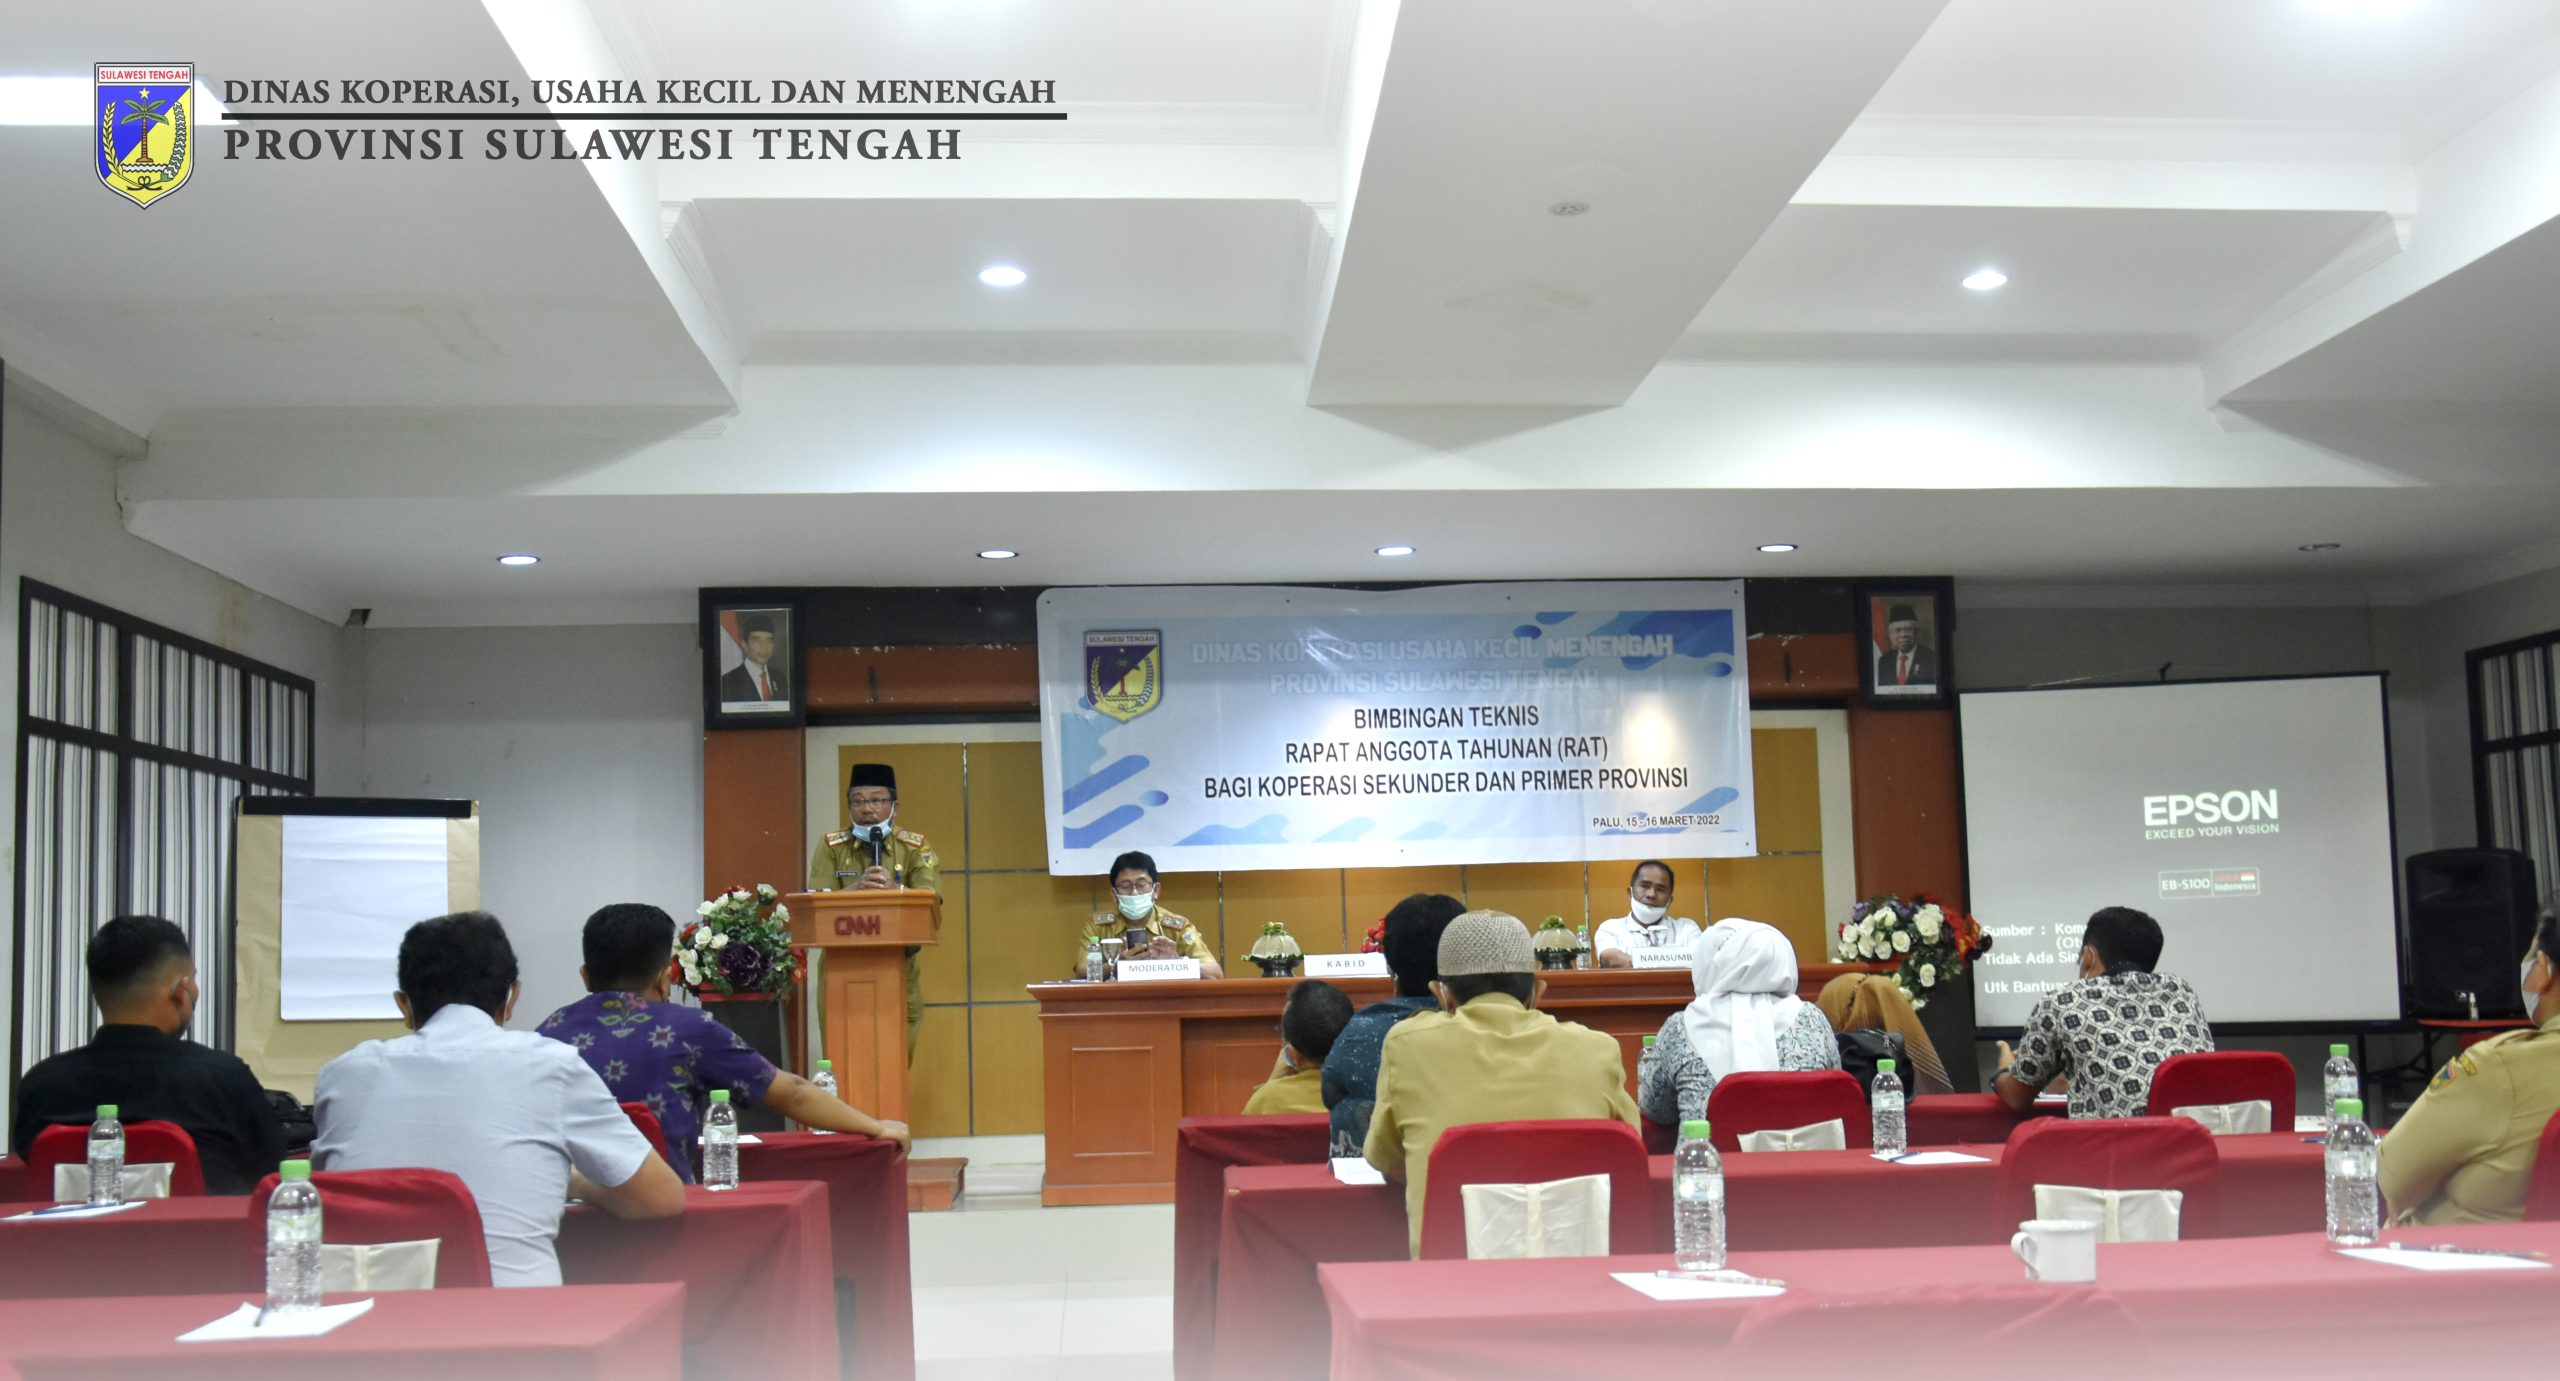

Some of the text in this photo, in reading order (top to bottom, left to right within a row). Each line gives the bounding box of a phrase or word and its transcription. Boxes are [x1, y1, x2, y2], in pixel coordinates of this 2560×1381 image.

[1192, 642, 1263, 664] DINAS
[1390, 638, 1468, 660] USAHA
[1474, 637, 1541, 659] KECIL
[1546, 634, 1674, 658] MENENGAH
[1269, 668, 1601, 695] PROVINSI SULAWESI TENGAH
[1354, 705, 1540, 729] BIMBINGAN TEKNIS
[1285, 736, 1608, 764] RAPAT ANGGOTA TAHUNAN (RAT)
[1204, 767, 1688, 799] BAGI KOPERASI SEKUNDER DAN PRIMER PROVINSI
[2143, 788, 2279, 826] EPSON
[1592, 817, 1623, 828] PALU,
[1627, 816, 1638, 827] 15
[1646, 816, 1658, 826] 16
[1659, 815, 1694, 826] MARET
[1696, 815, 1720, 825] 2022
[2145, 823, 2280, 840] EXCEED YOUR VISION
[2161, 878, 2210, 891] EB-S100
[1982, 923, 2034, 937] Sumber
[2056, 936, 2083, 950] (Ot
[1640, 954, 1695, 962] NARASUMB
[1984, 951, 2079, 965] Tidak Ada Sin
[1128, 963, 1189, 972] MODERATOR
[1984, 981, 2010, 993] Utk
